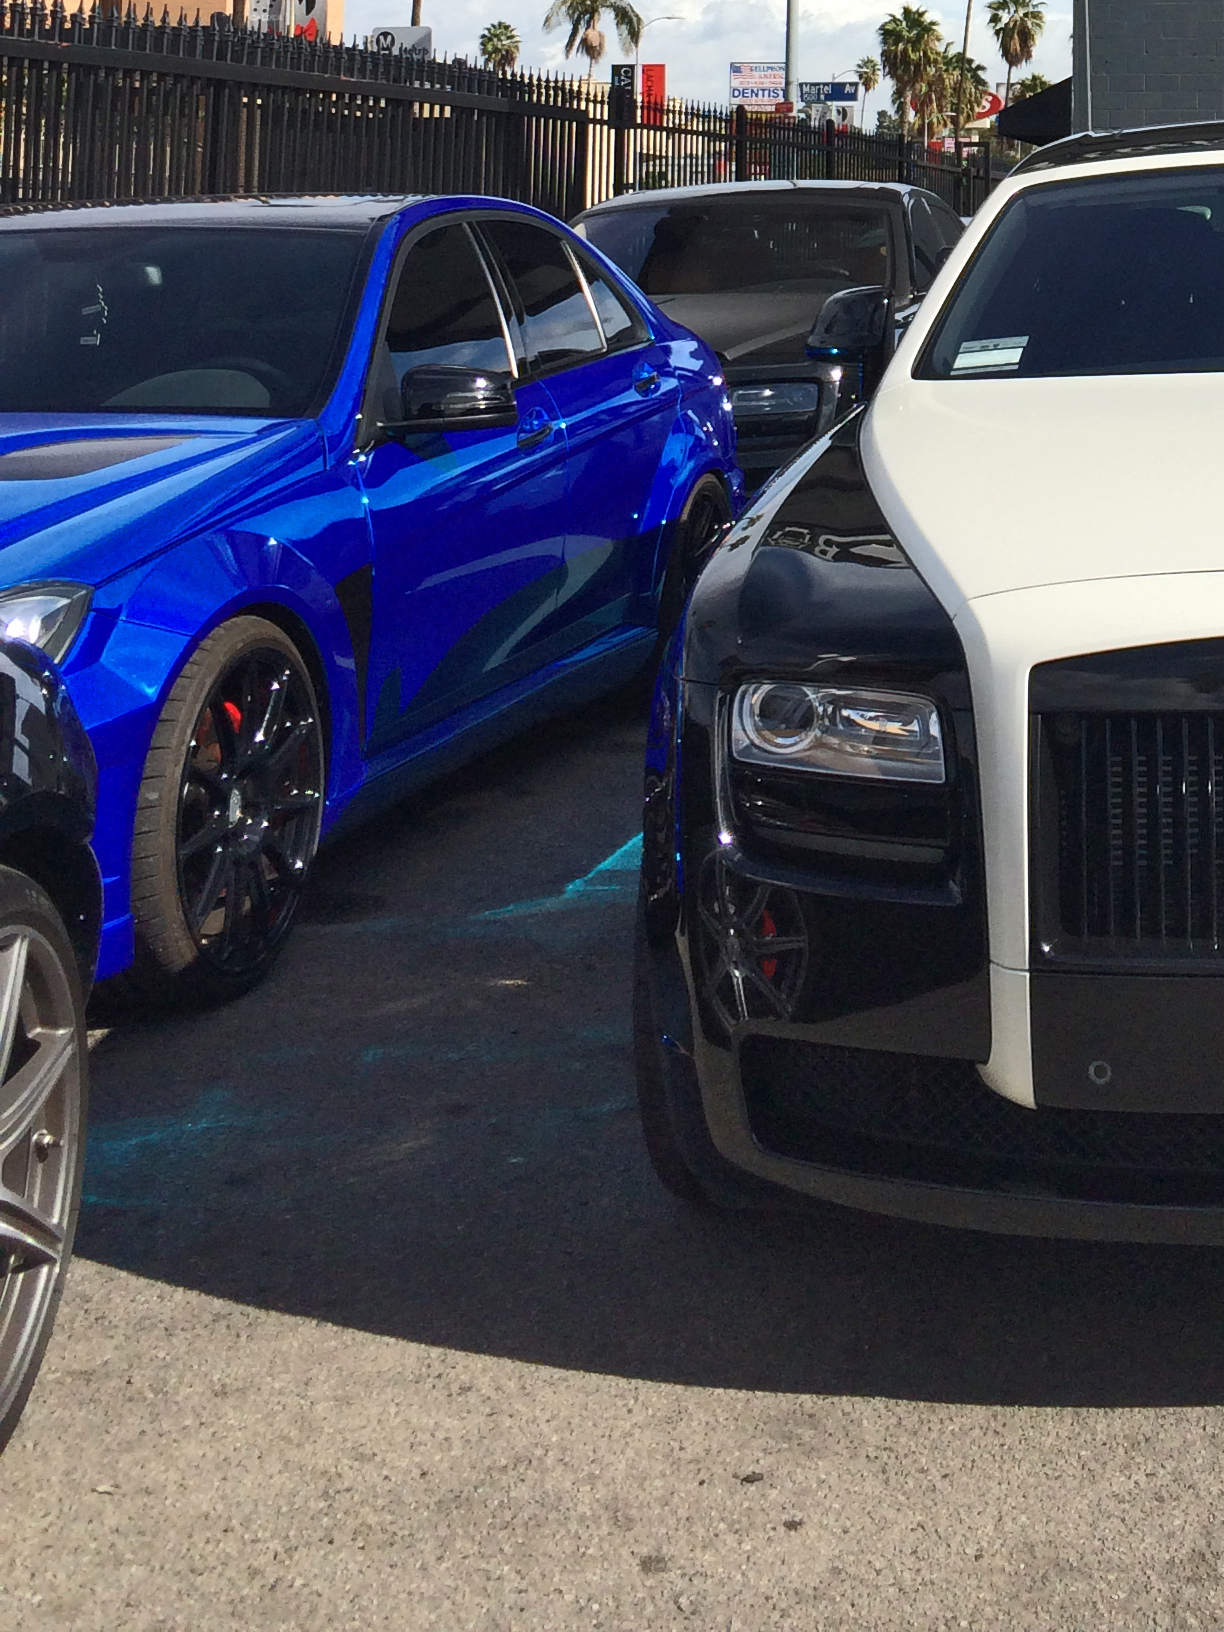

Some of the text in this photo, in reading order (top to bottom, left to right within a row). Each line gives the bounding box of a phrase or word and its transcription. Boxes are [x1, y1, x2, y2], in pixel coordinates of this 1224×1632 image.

[732, 88, 787, 99] DENTIST
[802, 83, 856, 94] Martel Av
